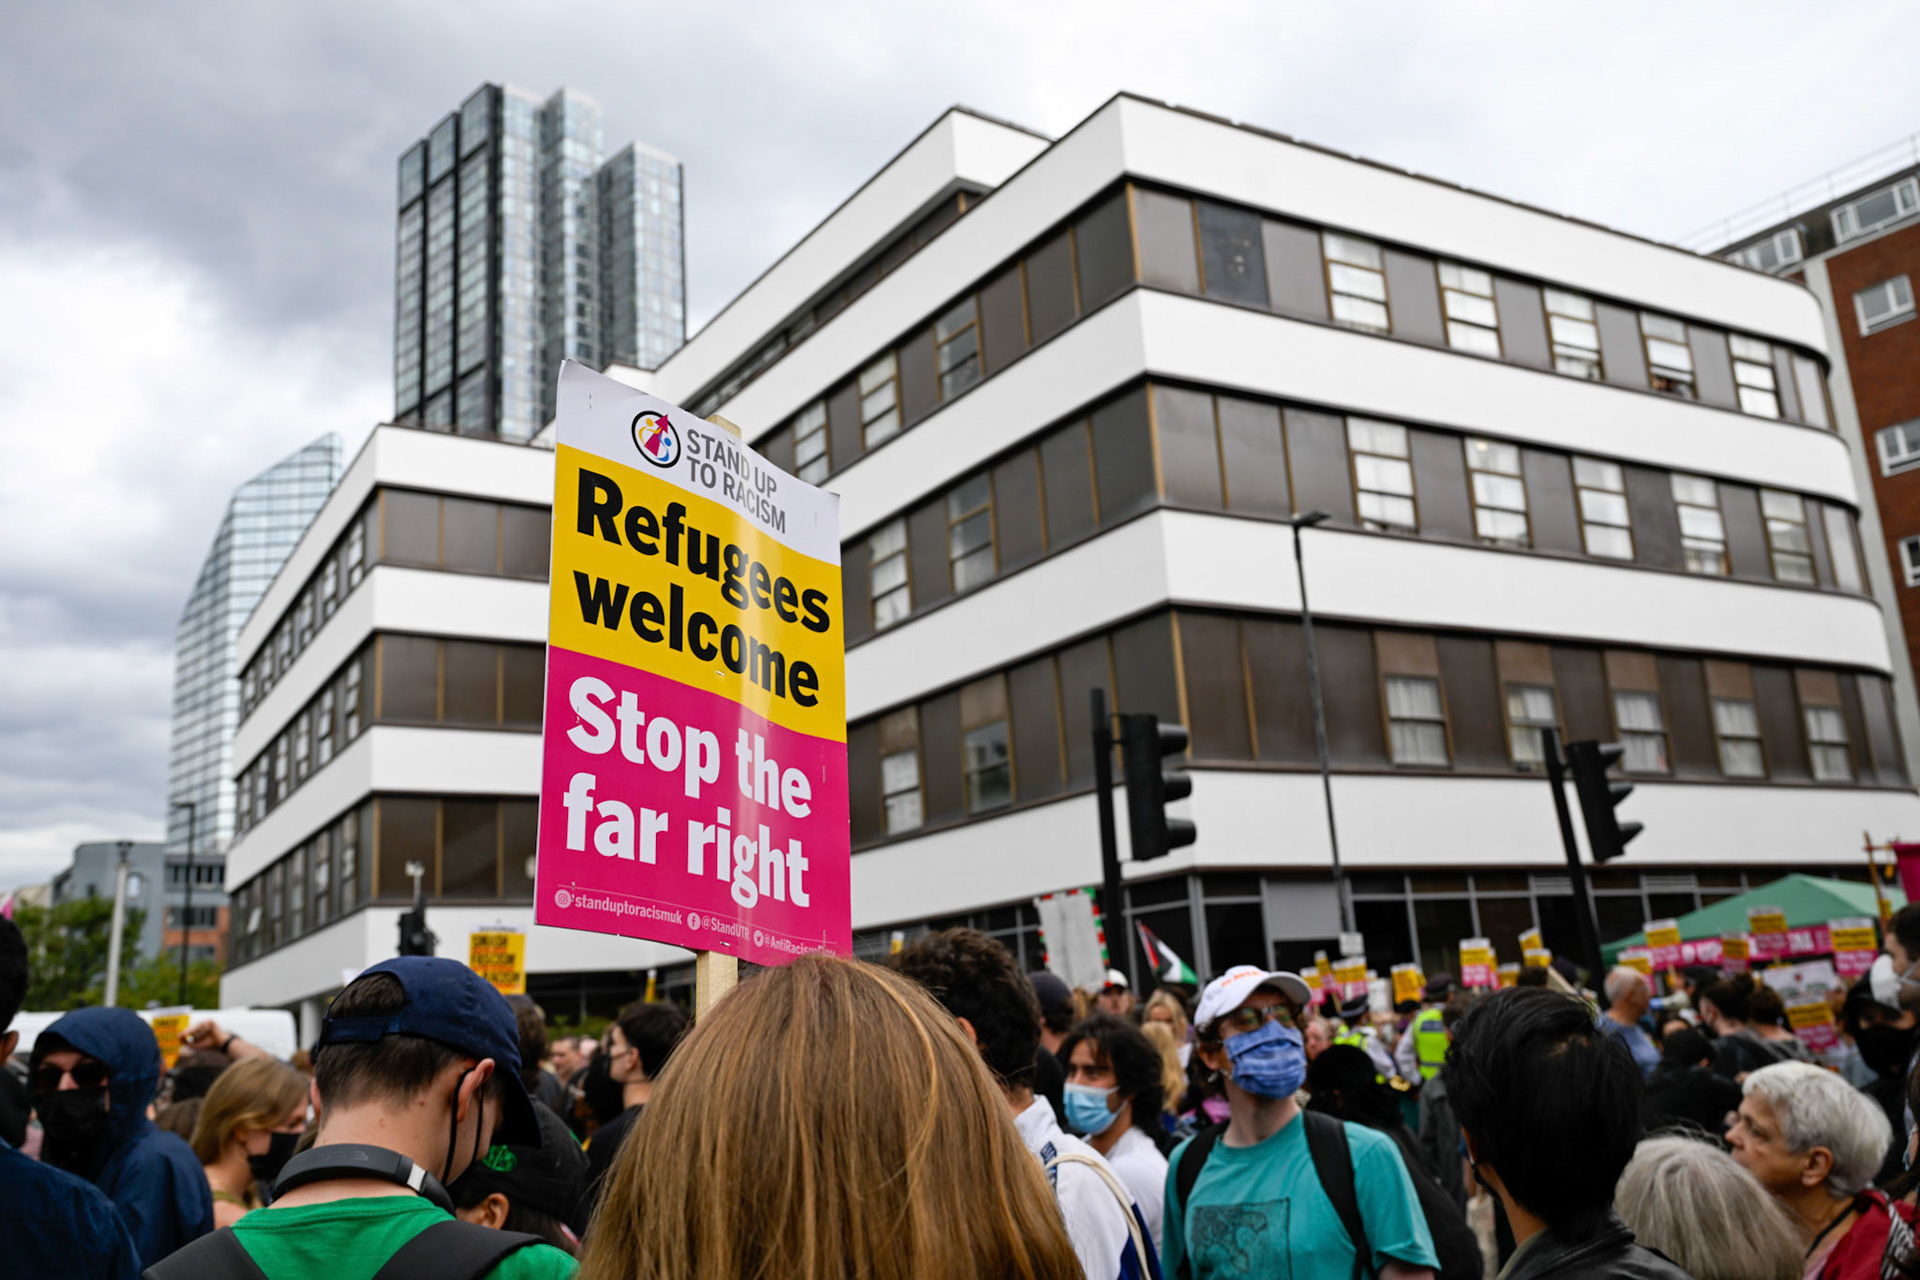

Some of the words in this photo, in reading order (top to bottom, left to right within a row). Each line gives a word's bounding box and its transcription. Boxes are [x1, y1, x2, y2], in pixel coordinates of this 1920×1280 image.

[686, 455, 716, 489] TO
[723, 471, 785, 534] RACISM
[687, 429, 750, 481] STAND
[755, 466, 777, 498] UP
[576, 467, 830, 633] Refugees
[573, 570, 819, 708] welcome
[566, 676, 720, 799] Stop
[735, 728, 812, 818] the
[563, 772, 669, 864] far
[687, 806, 810, 909] right
[575, 894, 682, 925] standuptoracismuk
[702, 915, 750, 941] @StandUTR
